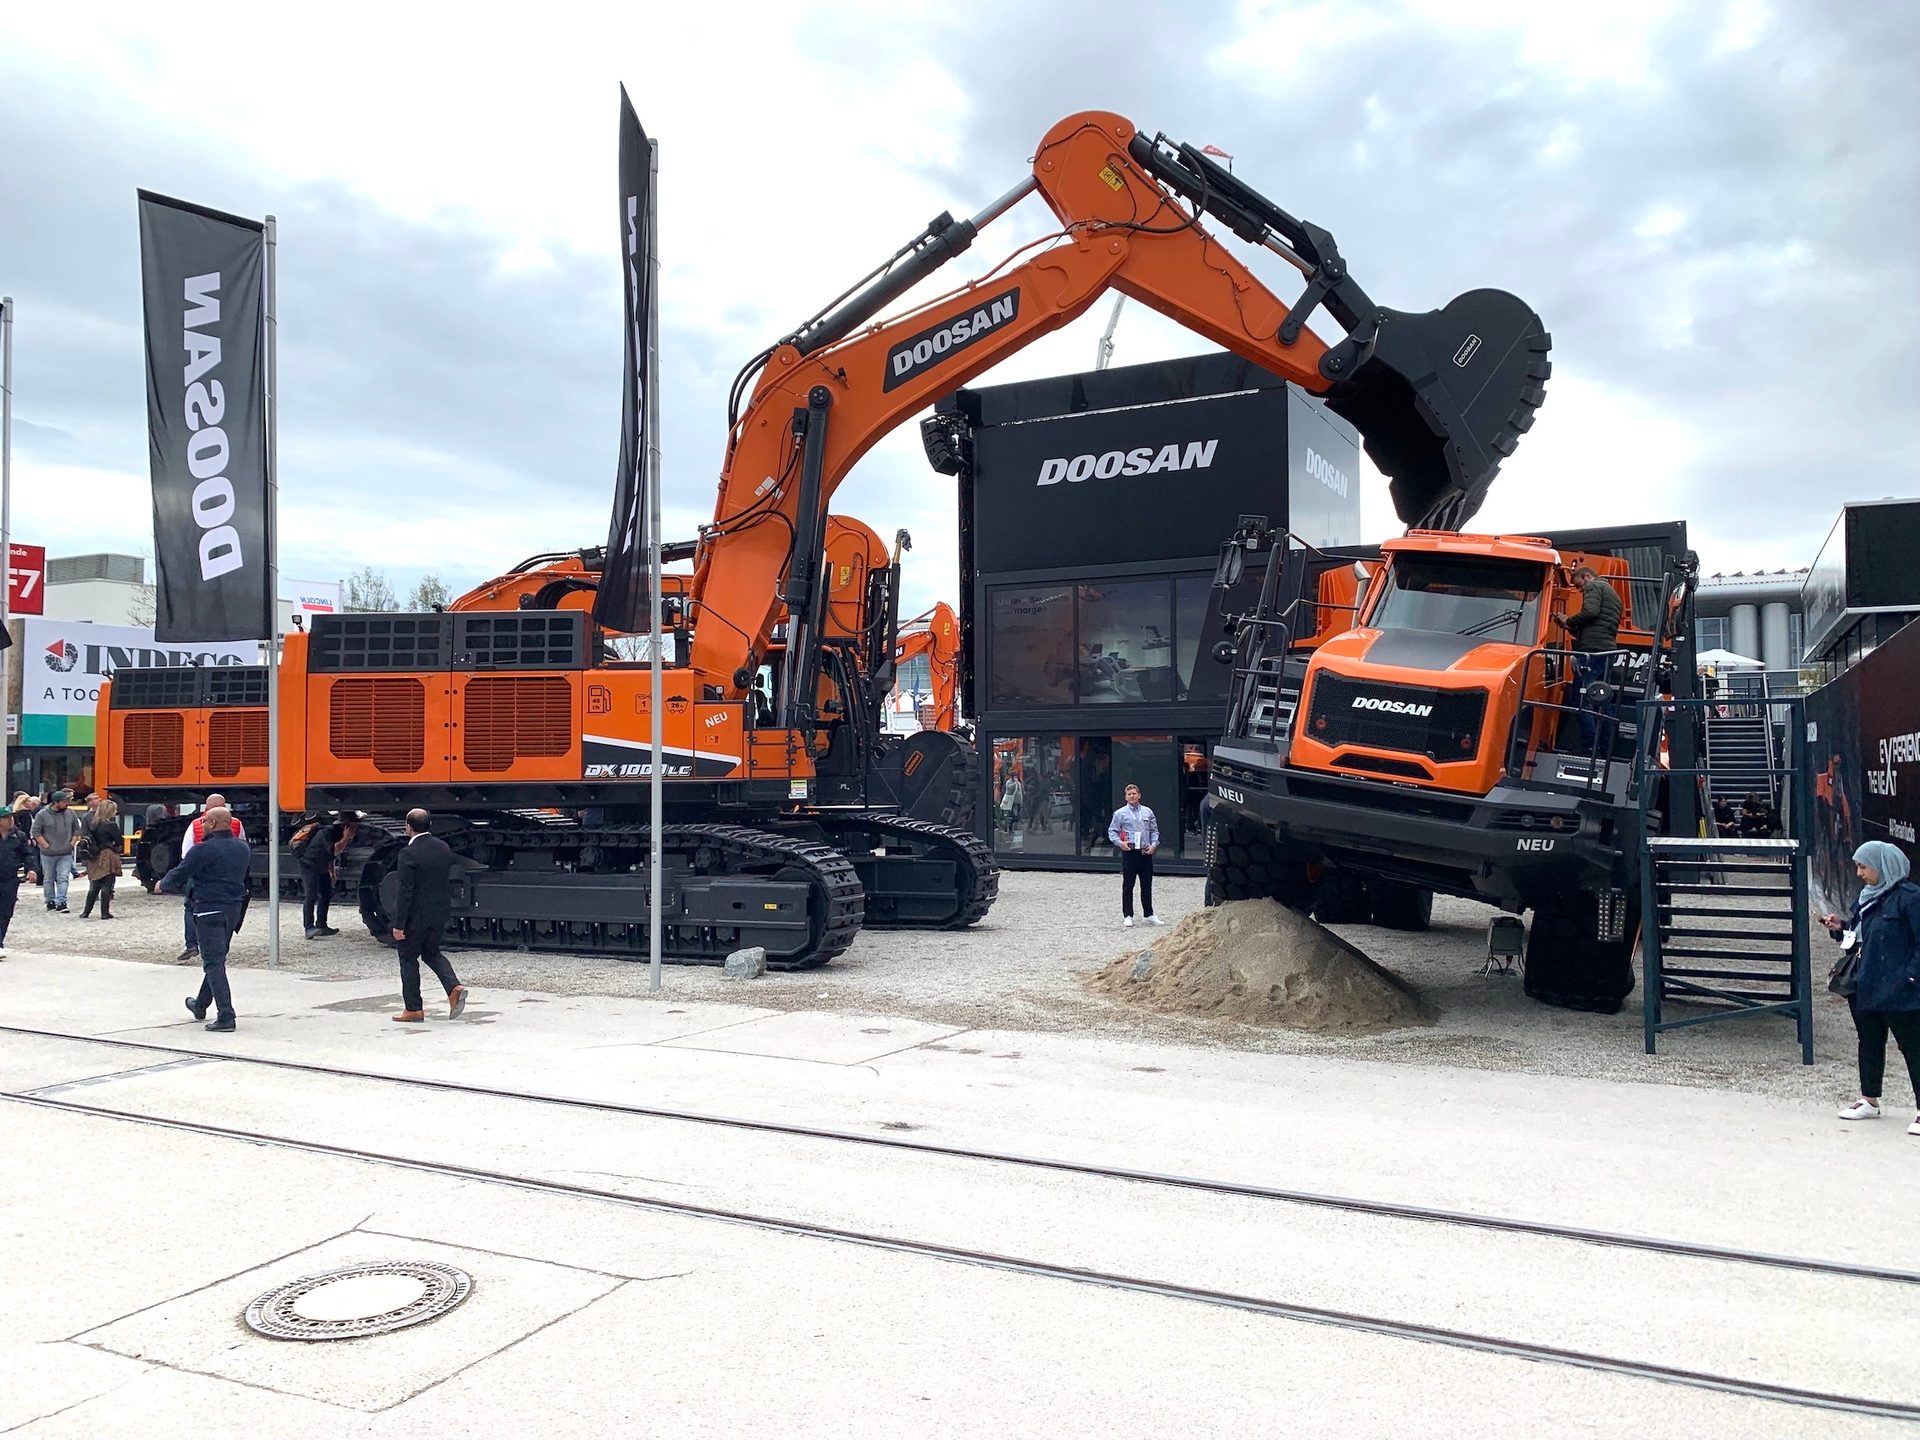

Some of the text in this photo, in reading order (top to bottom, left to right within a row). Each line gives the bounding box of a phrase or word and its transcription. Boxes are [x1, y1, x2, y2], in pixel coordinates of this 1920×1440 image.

[892, 294, 1016, 377] DOOSAN
[1458, 338, 1477, 363] DOOSAN
[1036, 439, 1219, 486] DOOSAN
[1306, 446, 1348, 500] DOOSAN
[43, 687, 55, 700] A
[1352, 696, 1433, 717] DOOSAN
[705, 711, 728, 728] NEU
[584, 763, 618, 777] DX
[1218, 786, 1245, 804] NEU
[1516, 837, 1555, 852] NEU
